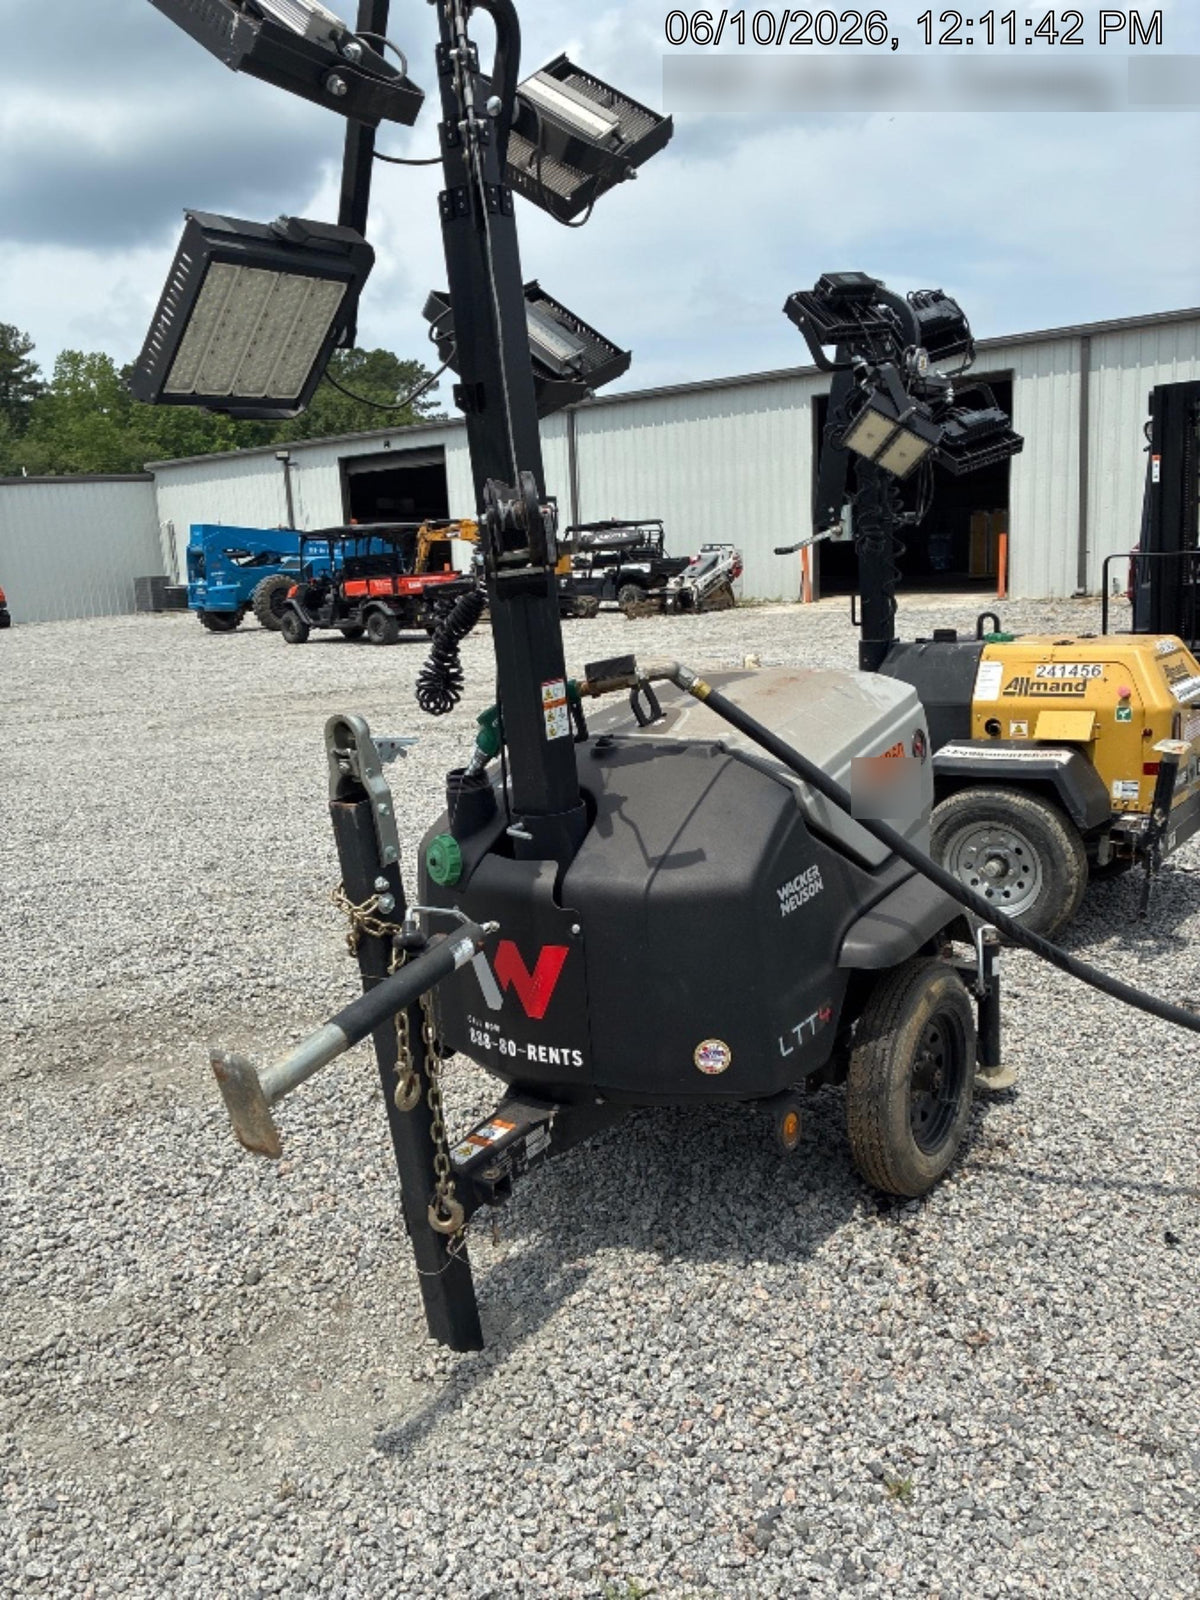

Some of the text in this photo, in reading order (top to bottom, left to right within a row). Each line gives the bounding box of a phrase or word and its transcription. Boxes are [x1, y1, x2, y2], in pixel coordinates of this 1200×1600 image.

[1036, 664, 1102, 678] 241456
[1003, 676, 1088, 697] Allmand
[776, 863, 821, 902] WACKER
[779, 876, 825, 918] NEUSON
